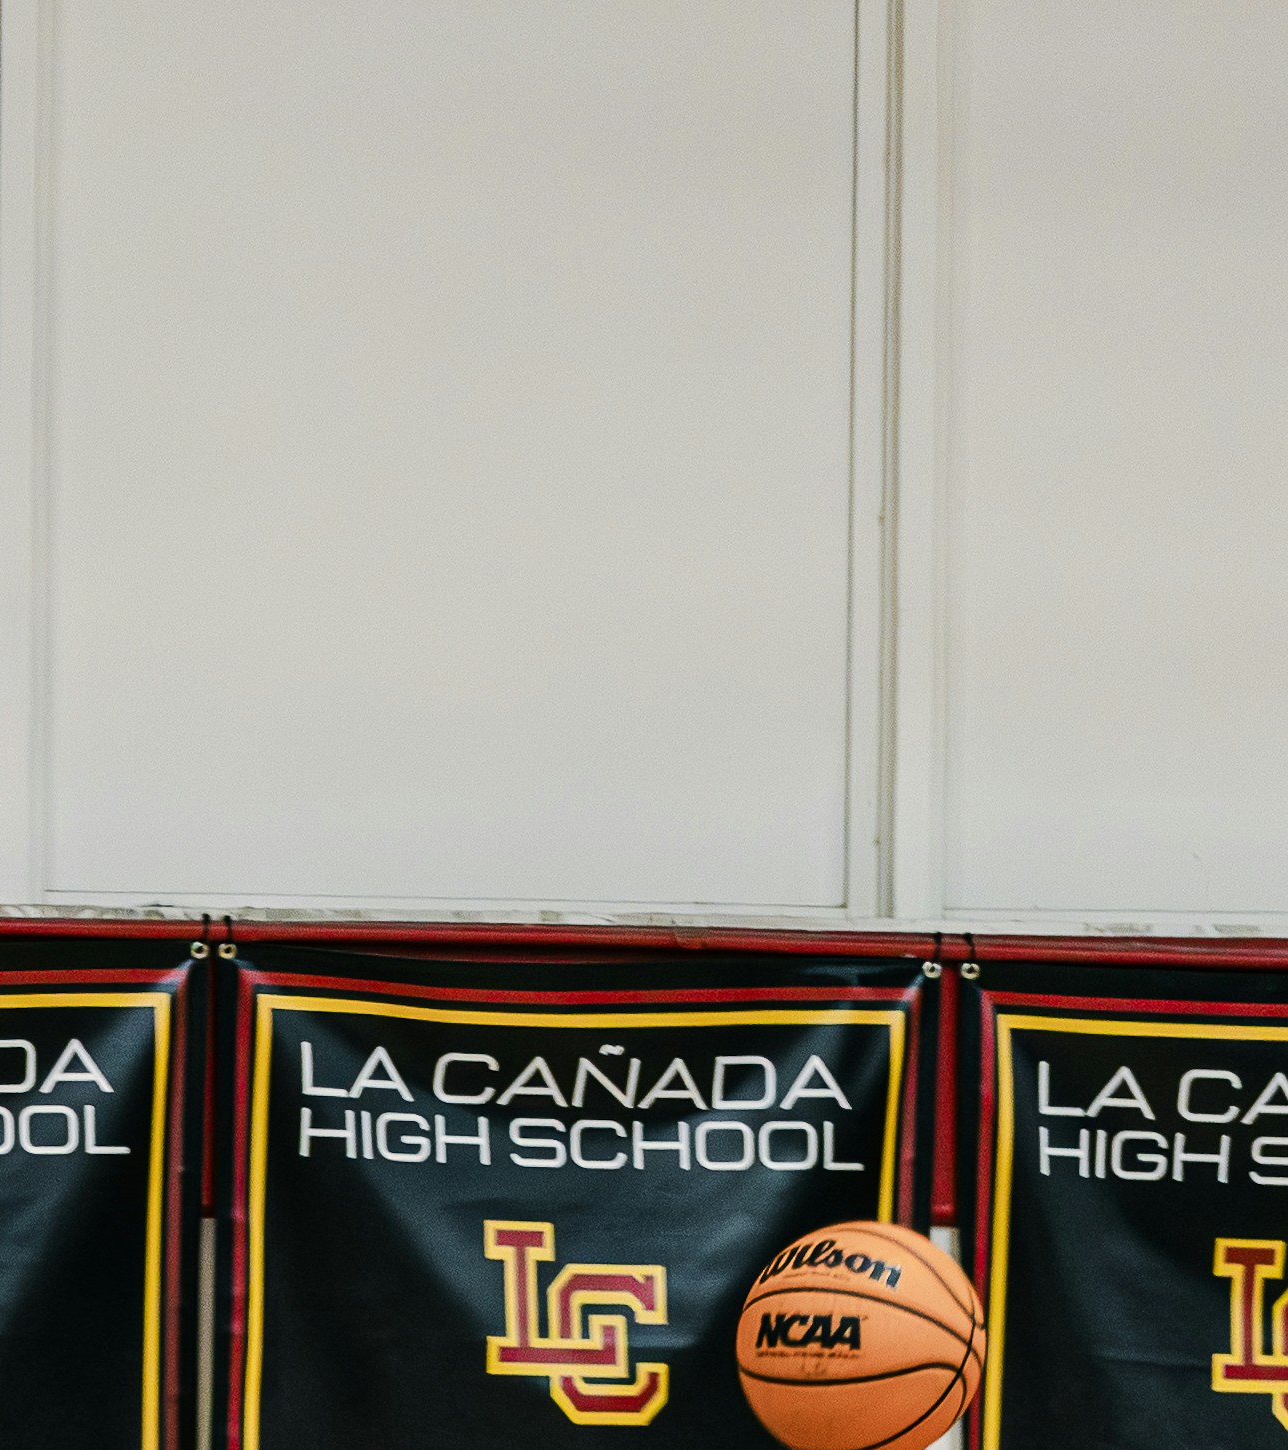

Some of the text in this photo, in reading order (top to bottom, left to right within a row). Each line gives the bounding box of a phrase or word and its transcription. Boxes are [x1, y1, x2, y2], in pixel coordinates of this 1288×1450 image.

[300, 1040, 853, 1111] LA CAÑADA
[1037, 1060, 1156, 1121] LA
[299, 1106, 864, 1172] HIGH SCHOOL
[1038, 1125, 1231, 1184] HIGH
[758, 1238, 905, 1291] Wilson
[755, 1312, 863, 1350] NCAA
